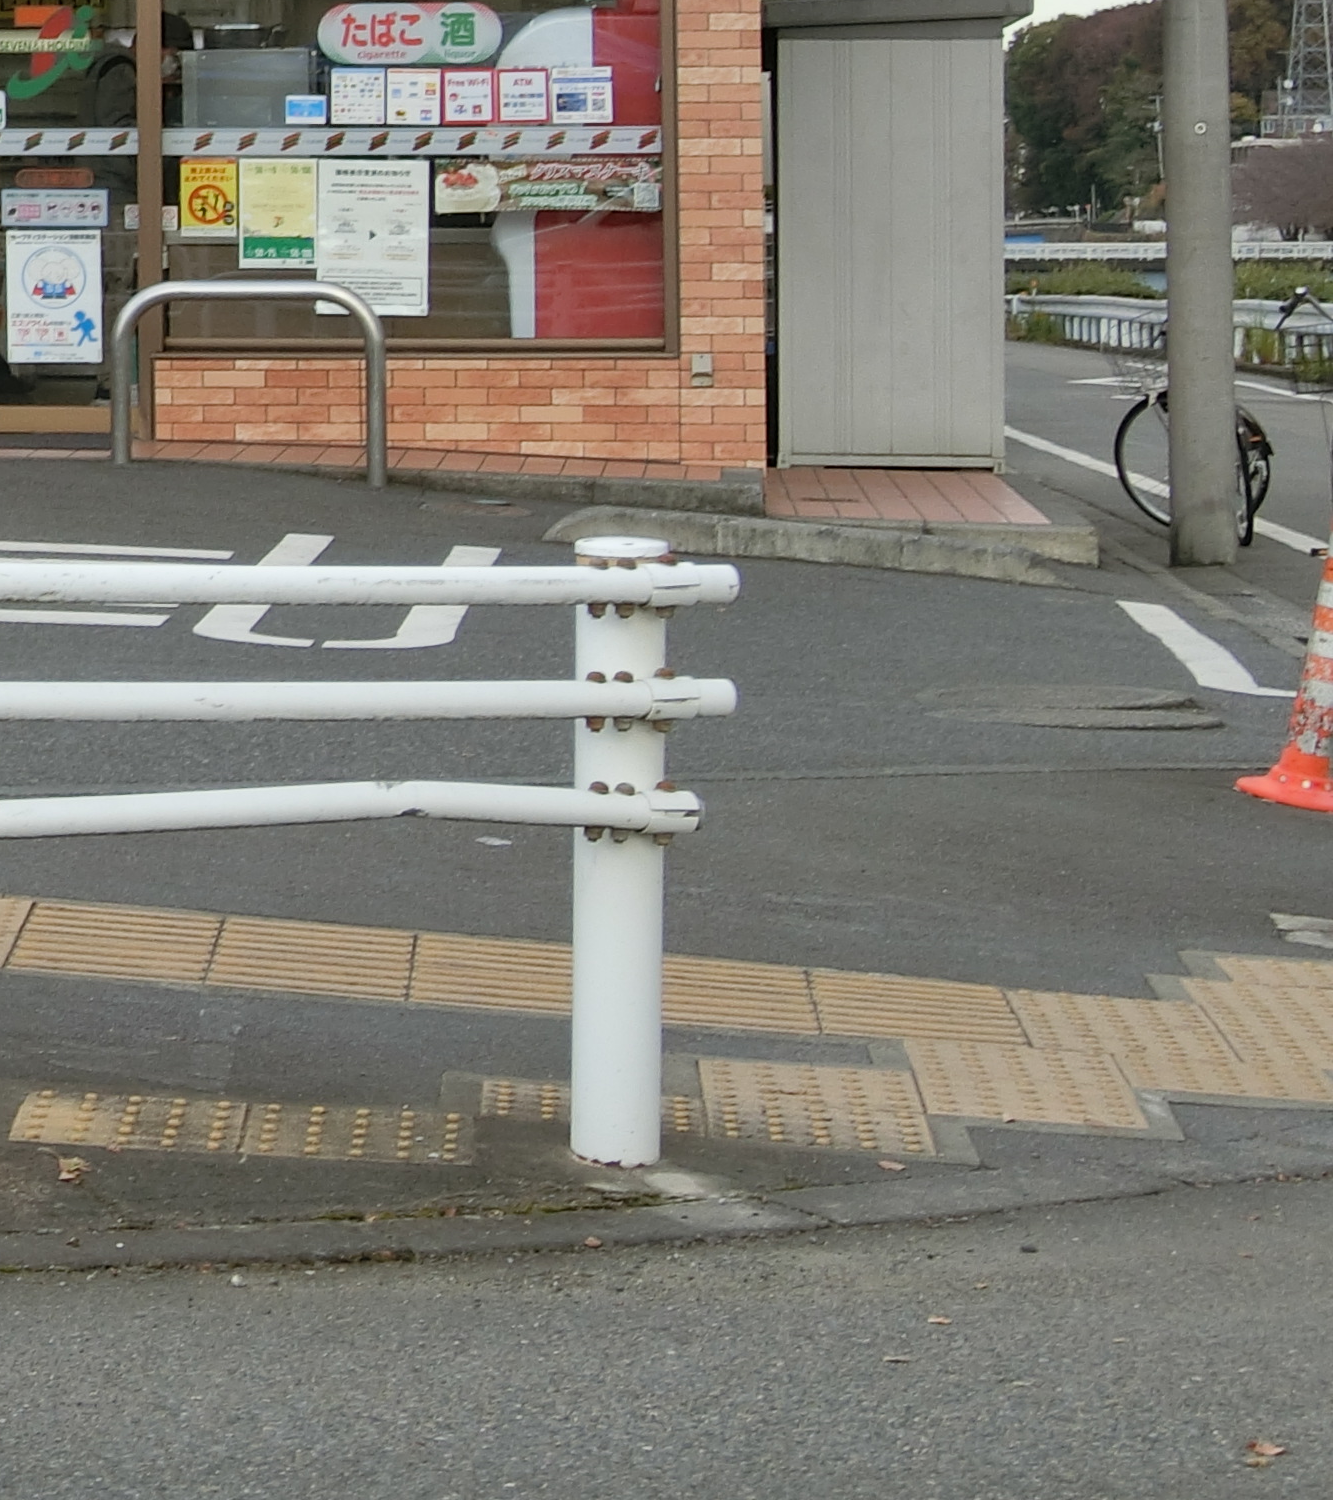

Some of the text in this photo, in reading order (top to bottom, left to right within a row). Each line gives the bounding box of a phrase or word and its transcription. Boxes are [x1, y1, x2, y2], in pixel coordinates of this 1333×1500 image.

[341, 11, 476, 48] たばこ 酒
[447, 78, 465, 87] Free
[513, 78, 533, 86] ATM
